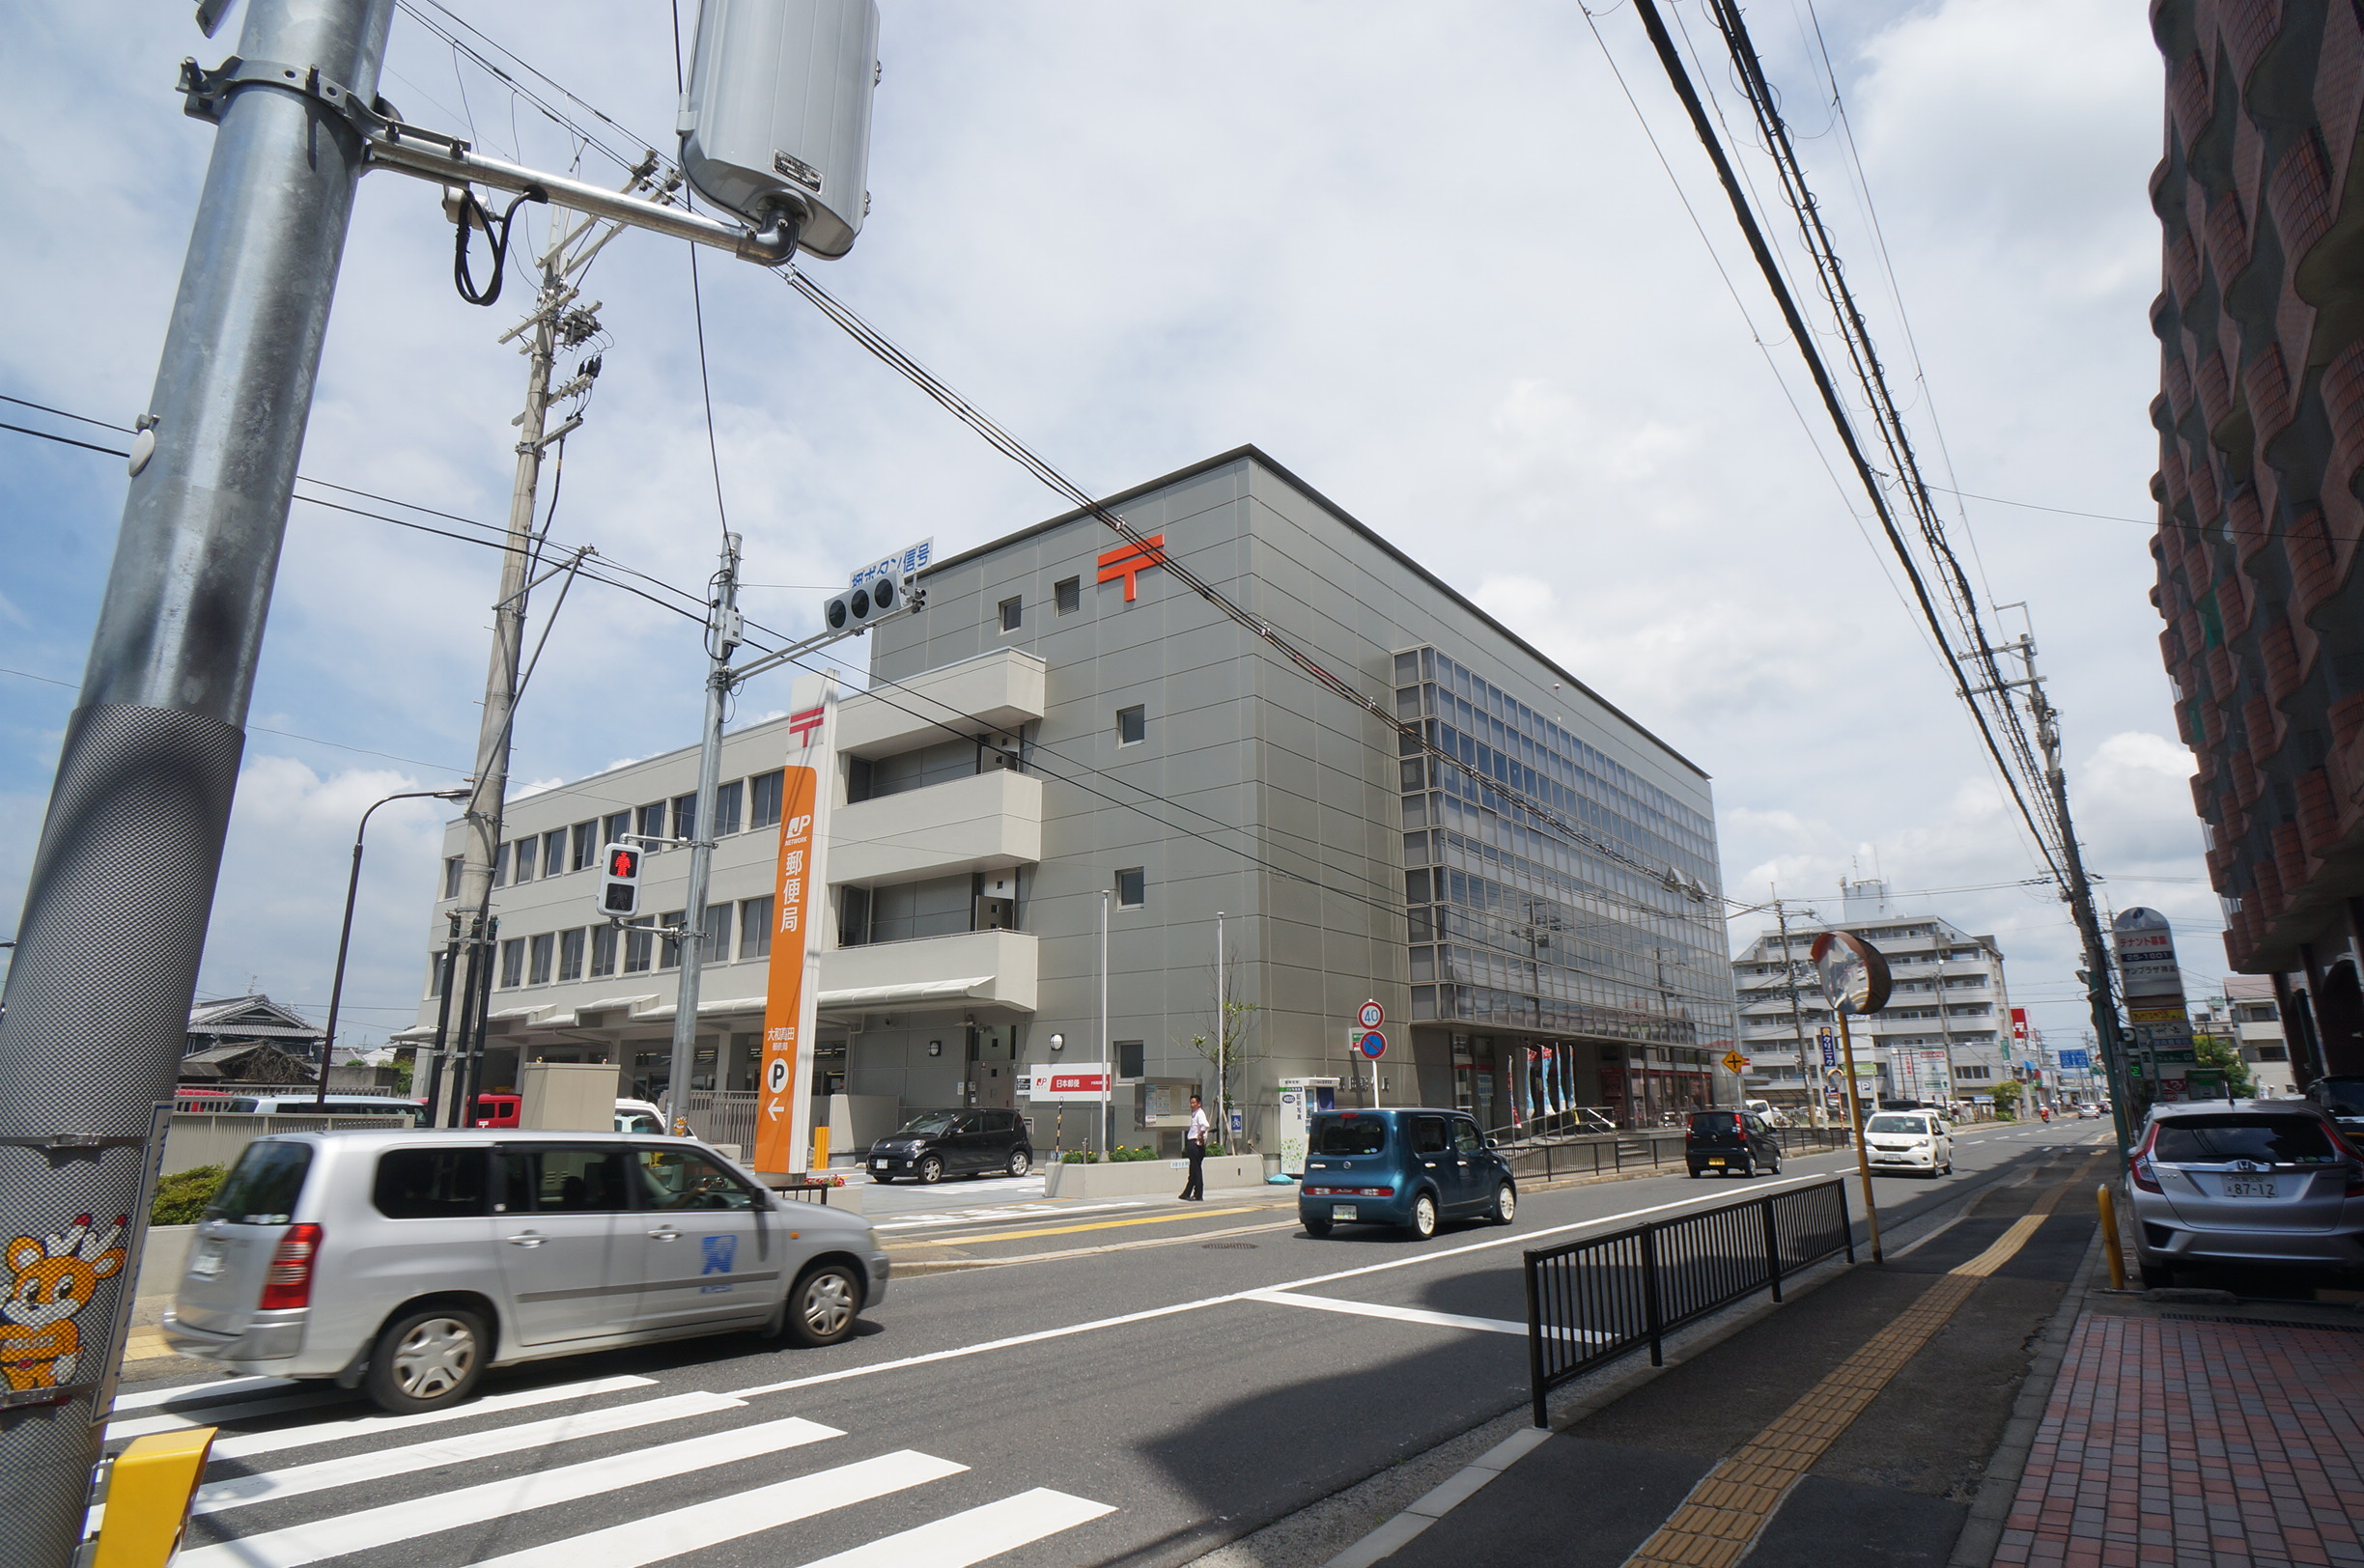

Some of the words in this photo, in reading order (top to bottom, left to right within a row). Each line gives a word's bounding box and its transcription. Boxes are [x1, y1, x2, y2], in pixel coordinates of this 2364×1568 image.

[784, 836, 807, 846] NETWORK
[780, 850, 803, 933] 郵便局
[2119, 936, 2168, 947] テナント募集
[2126, 952, 2169, 961] 25-1601
[1365, 1009, 1379, 1022] 40
[773, 1064, 784, 1088] P
[2234, 1183, 2276, 1196] 87-12
